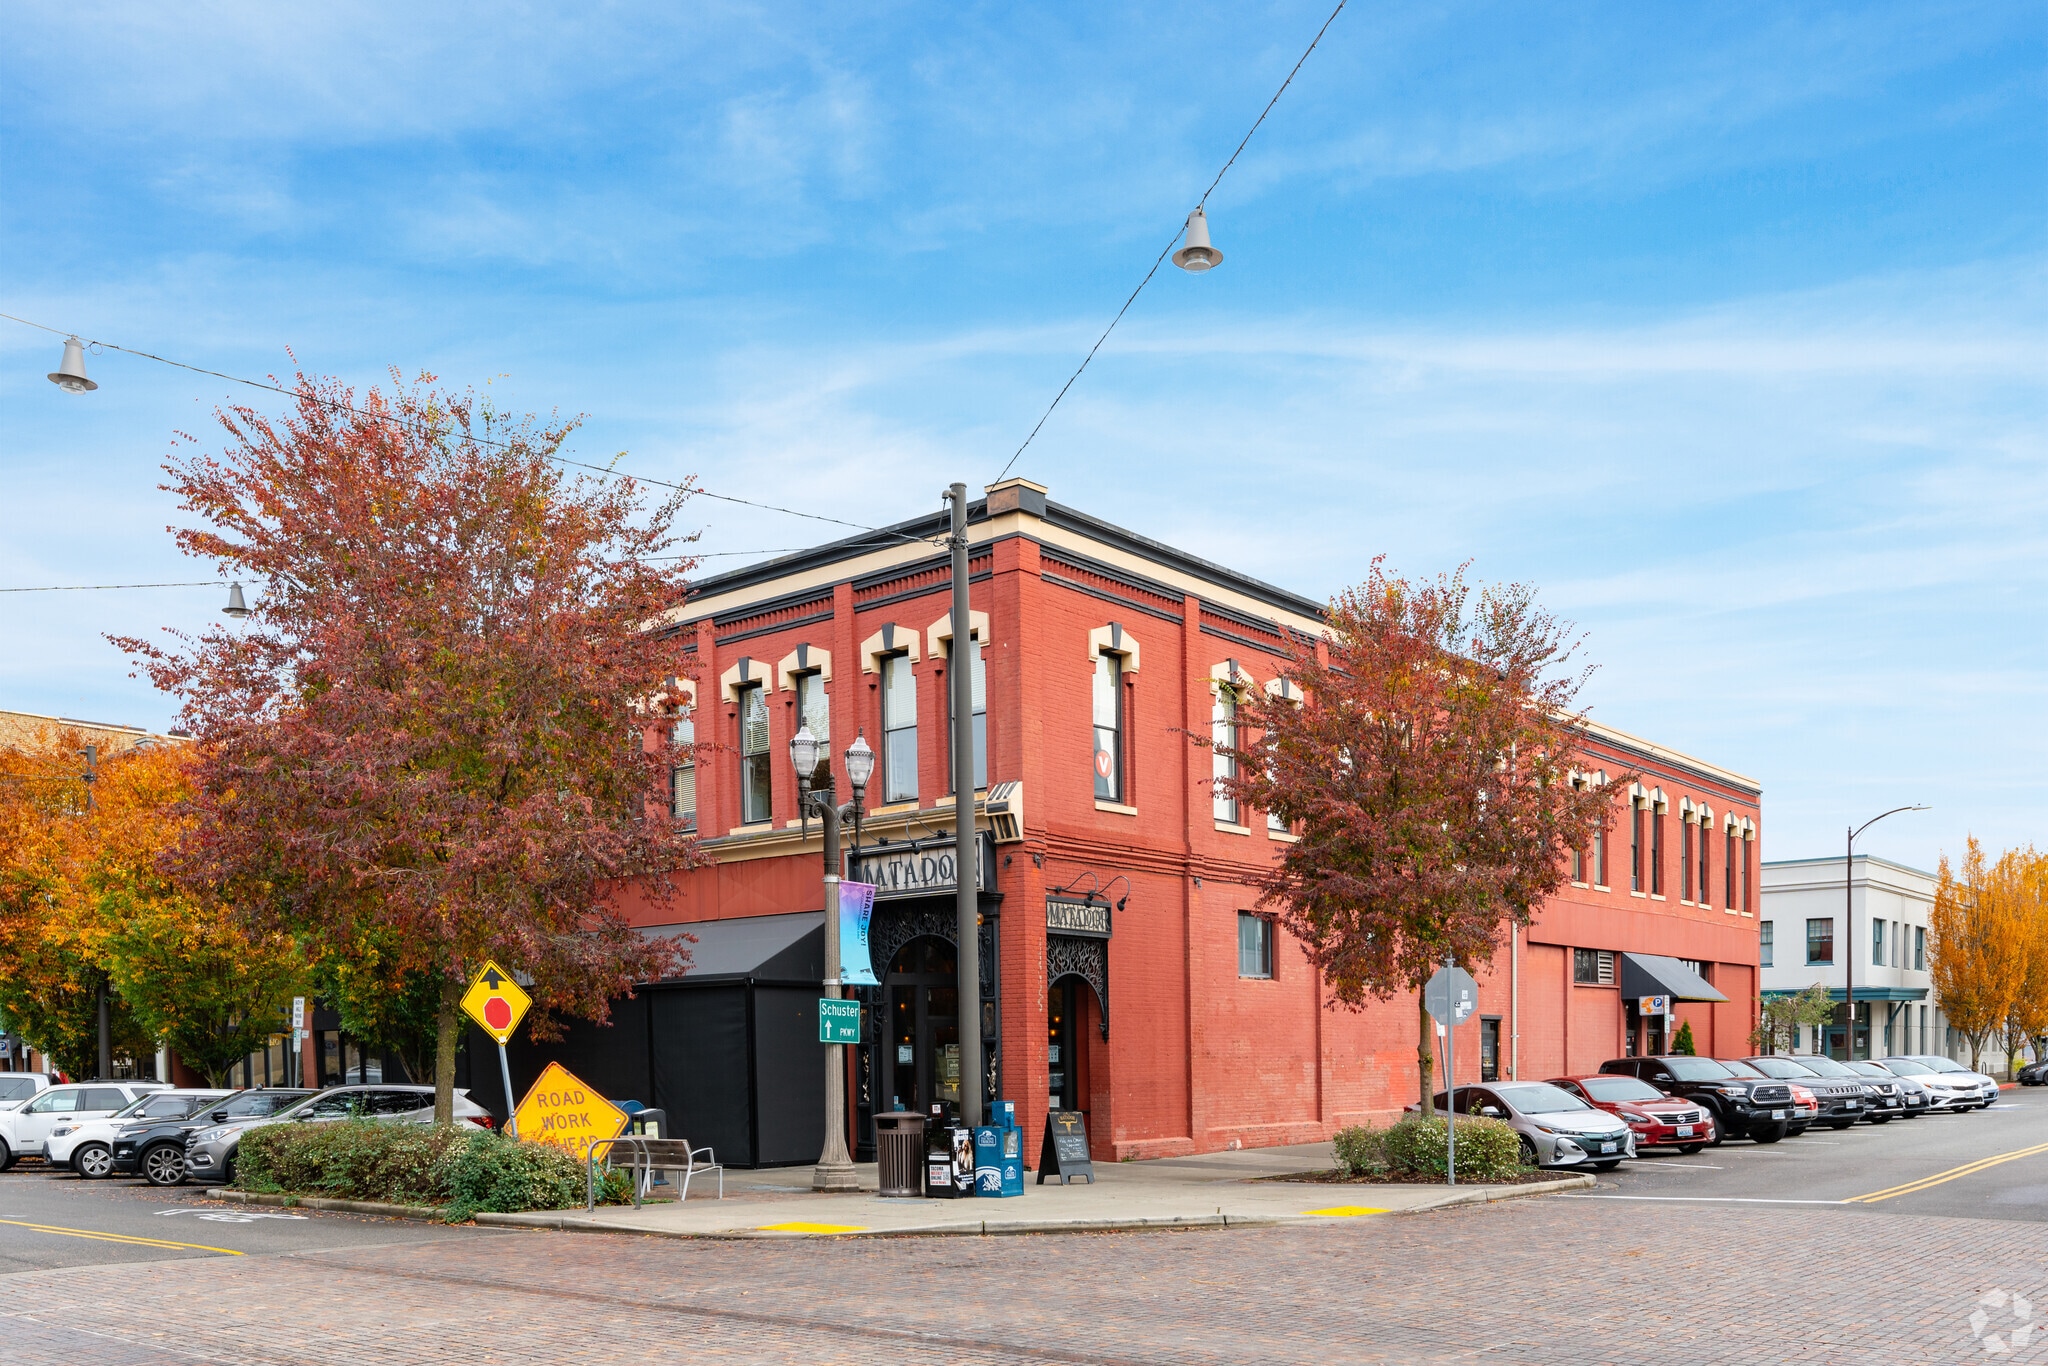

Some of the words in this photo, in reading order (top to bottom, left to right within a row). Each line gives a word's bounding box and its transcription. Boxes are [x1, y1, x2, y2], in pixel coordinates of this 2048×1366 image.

[1098, 756, 1109, 773] V
[861, 890, 873, 922] SHARE
[1050, 904, 1111, 930] MATADOR
[821, 1002, 859, 1017] Schuster
[840, 1027, 856, 1037] PKWY
[537, 1091, 585, 1108] ROAD
[541, 1113, 592, 1131] WORK
[558, 1135, 599, 1151] HEAD
